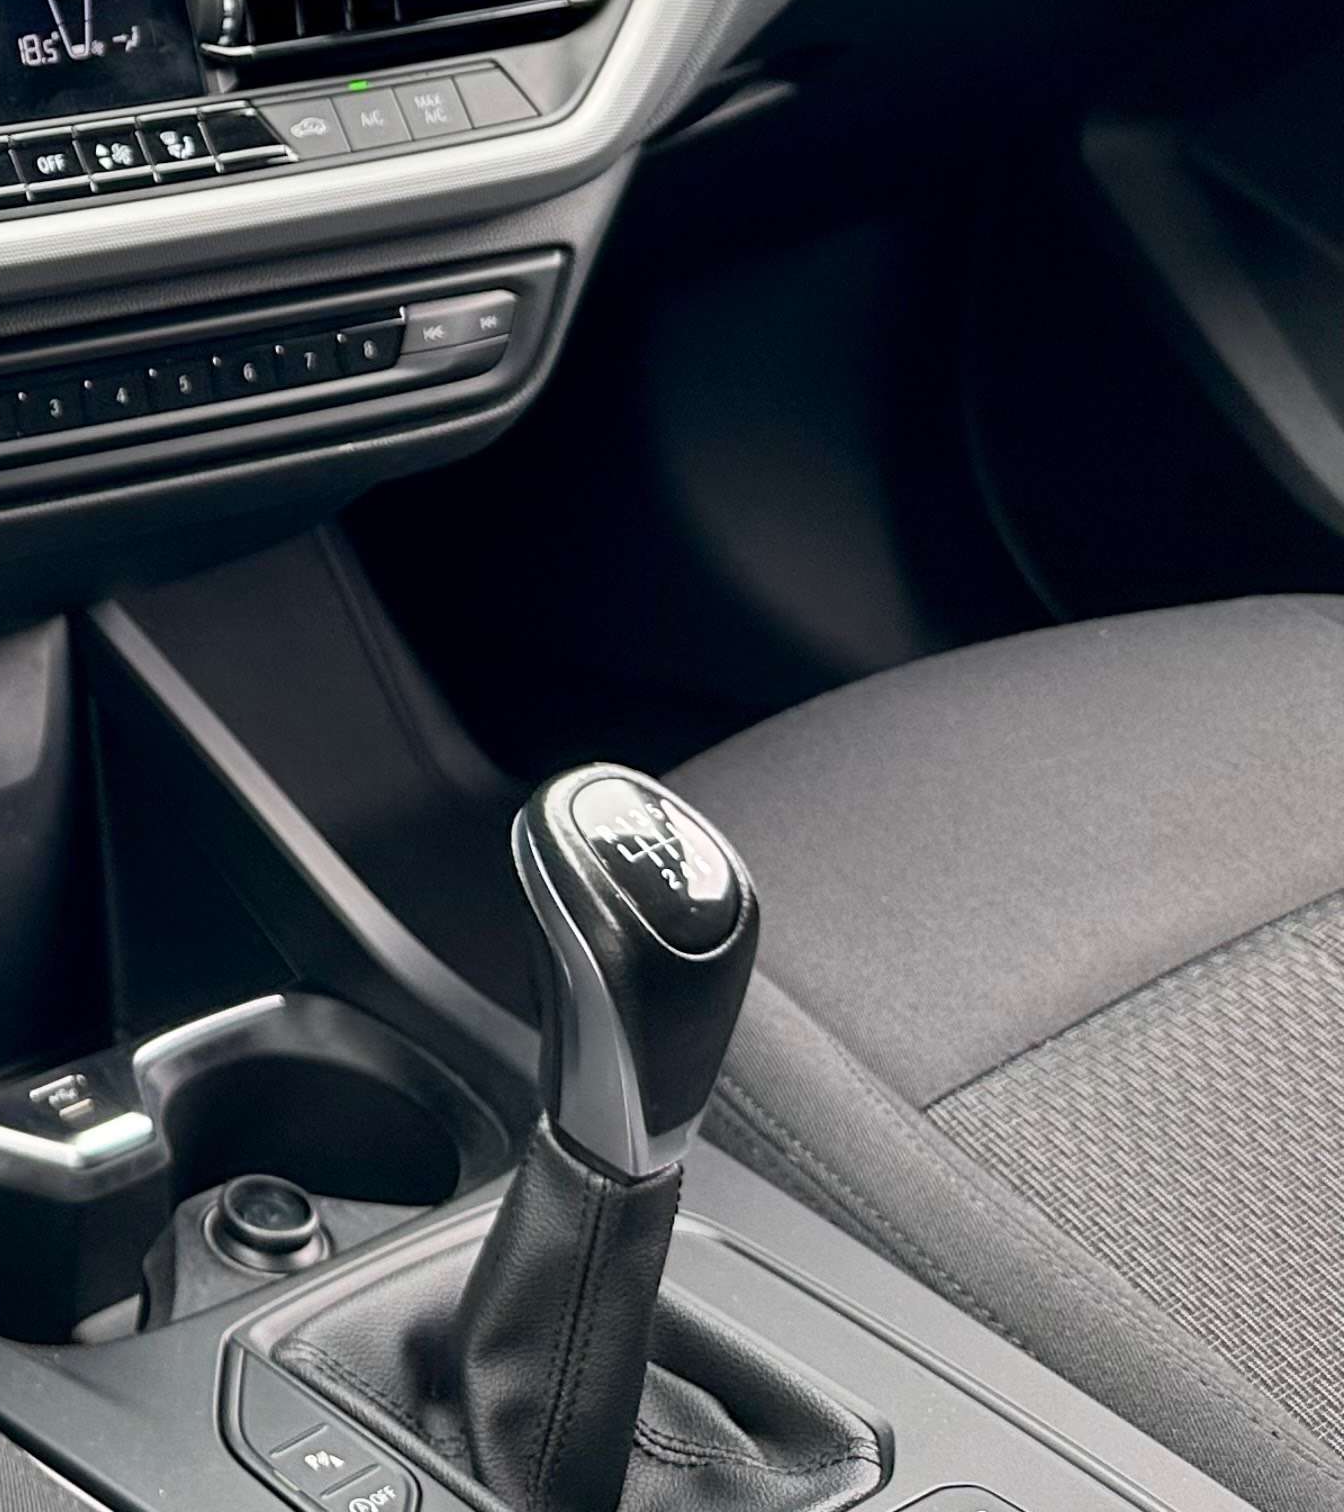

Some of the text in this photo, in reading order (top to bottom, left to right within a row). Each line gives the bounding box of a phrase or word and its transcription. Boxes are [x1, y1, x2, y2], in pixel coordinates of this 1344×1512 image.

[36, 153, 66, 175] OFF
[49, 397, 65, 420] 3
[116, 387, 131, 405] 4
[242, 362, 258, 383] 6
[368, 1485, 397, 1506] OFF
